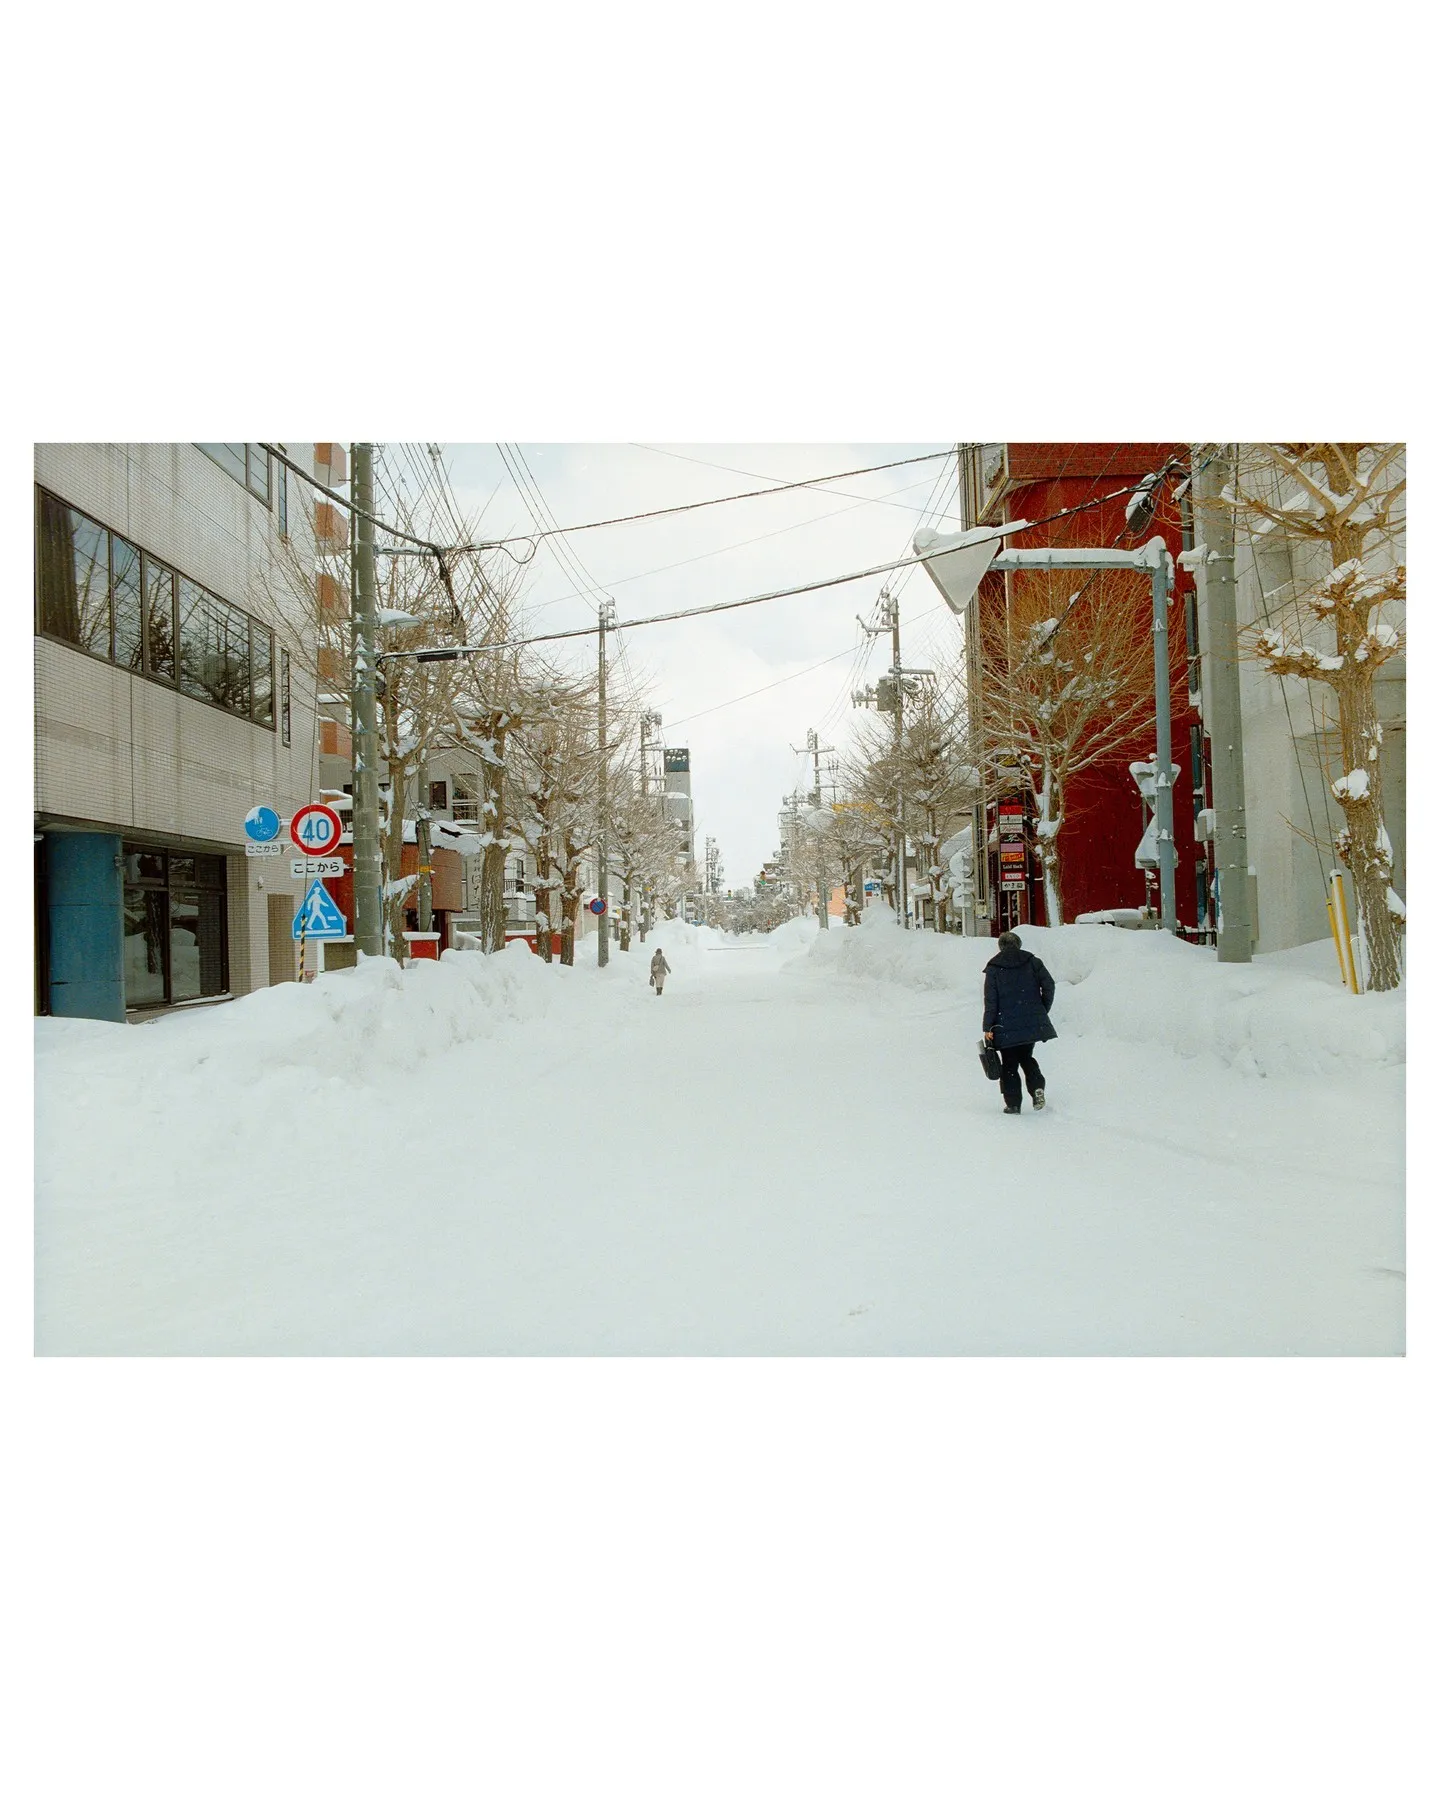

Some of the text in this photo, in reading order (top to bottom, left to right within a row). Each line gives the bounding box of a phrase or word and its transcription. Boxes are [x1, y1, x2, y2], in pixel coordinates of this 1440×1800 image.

[302, 818, 330, 841] 40
[247, 844, 279, 854] ここから
[293, 861, 340, 874] ここから
